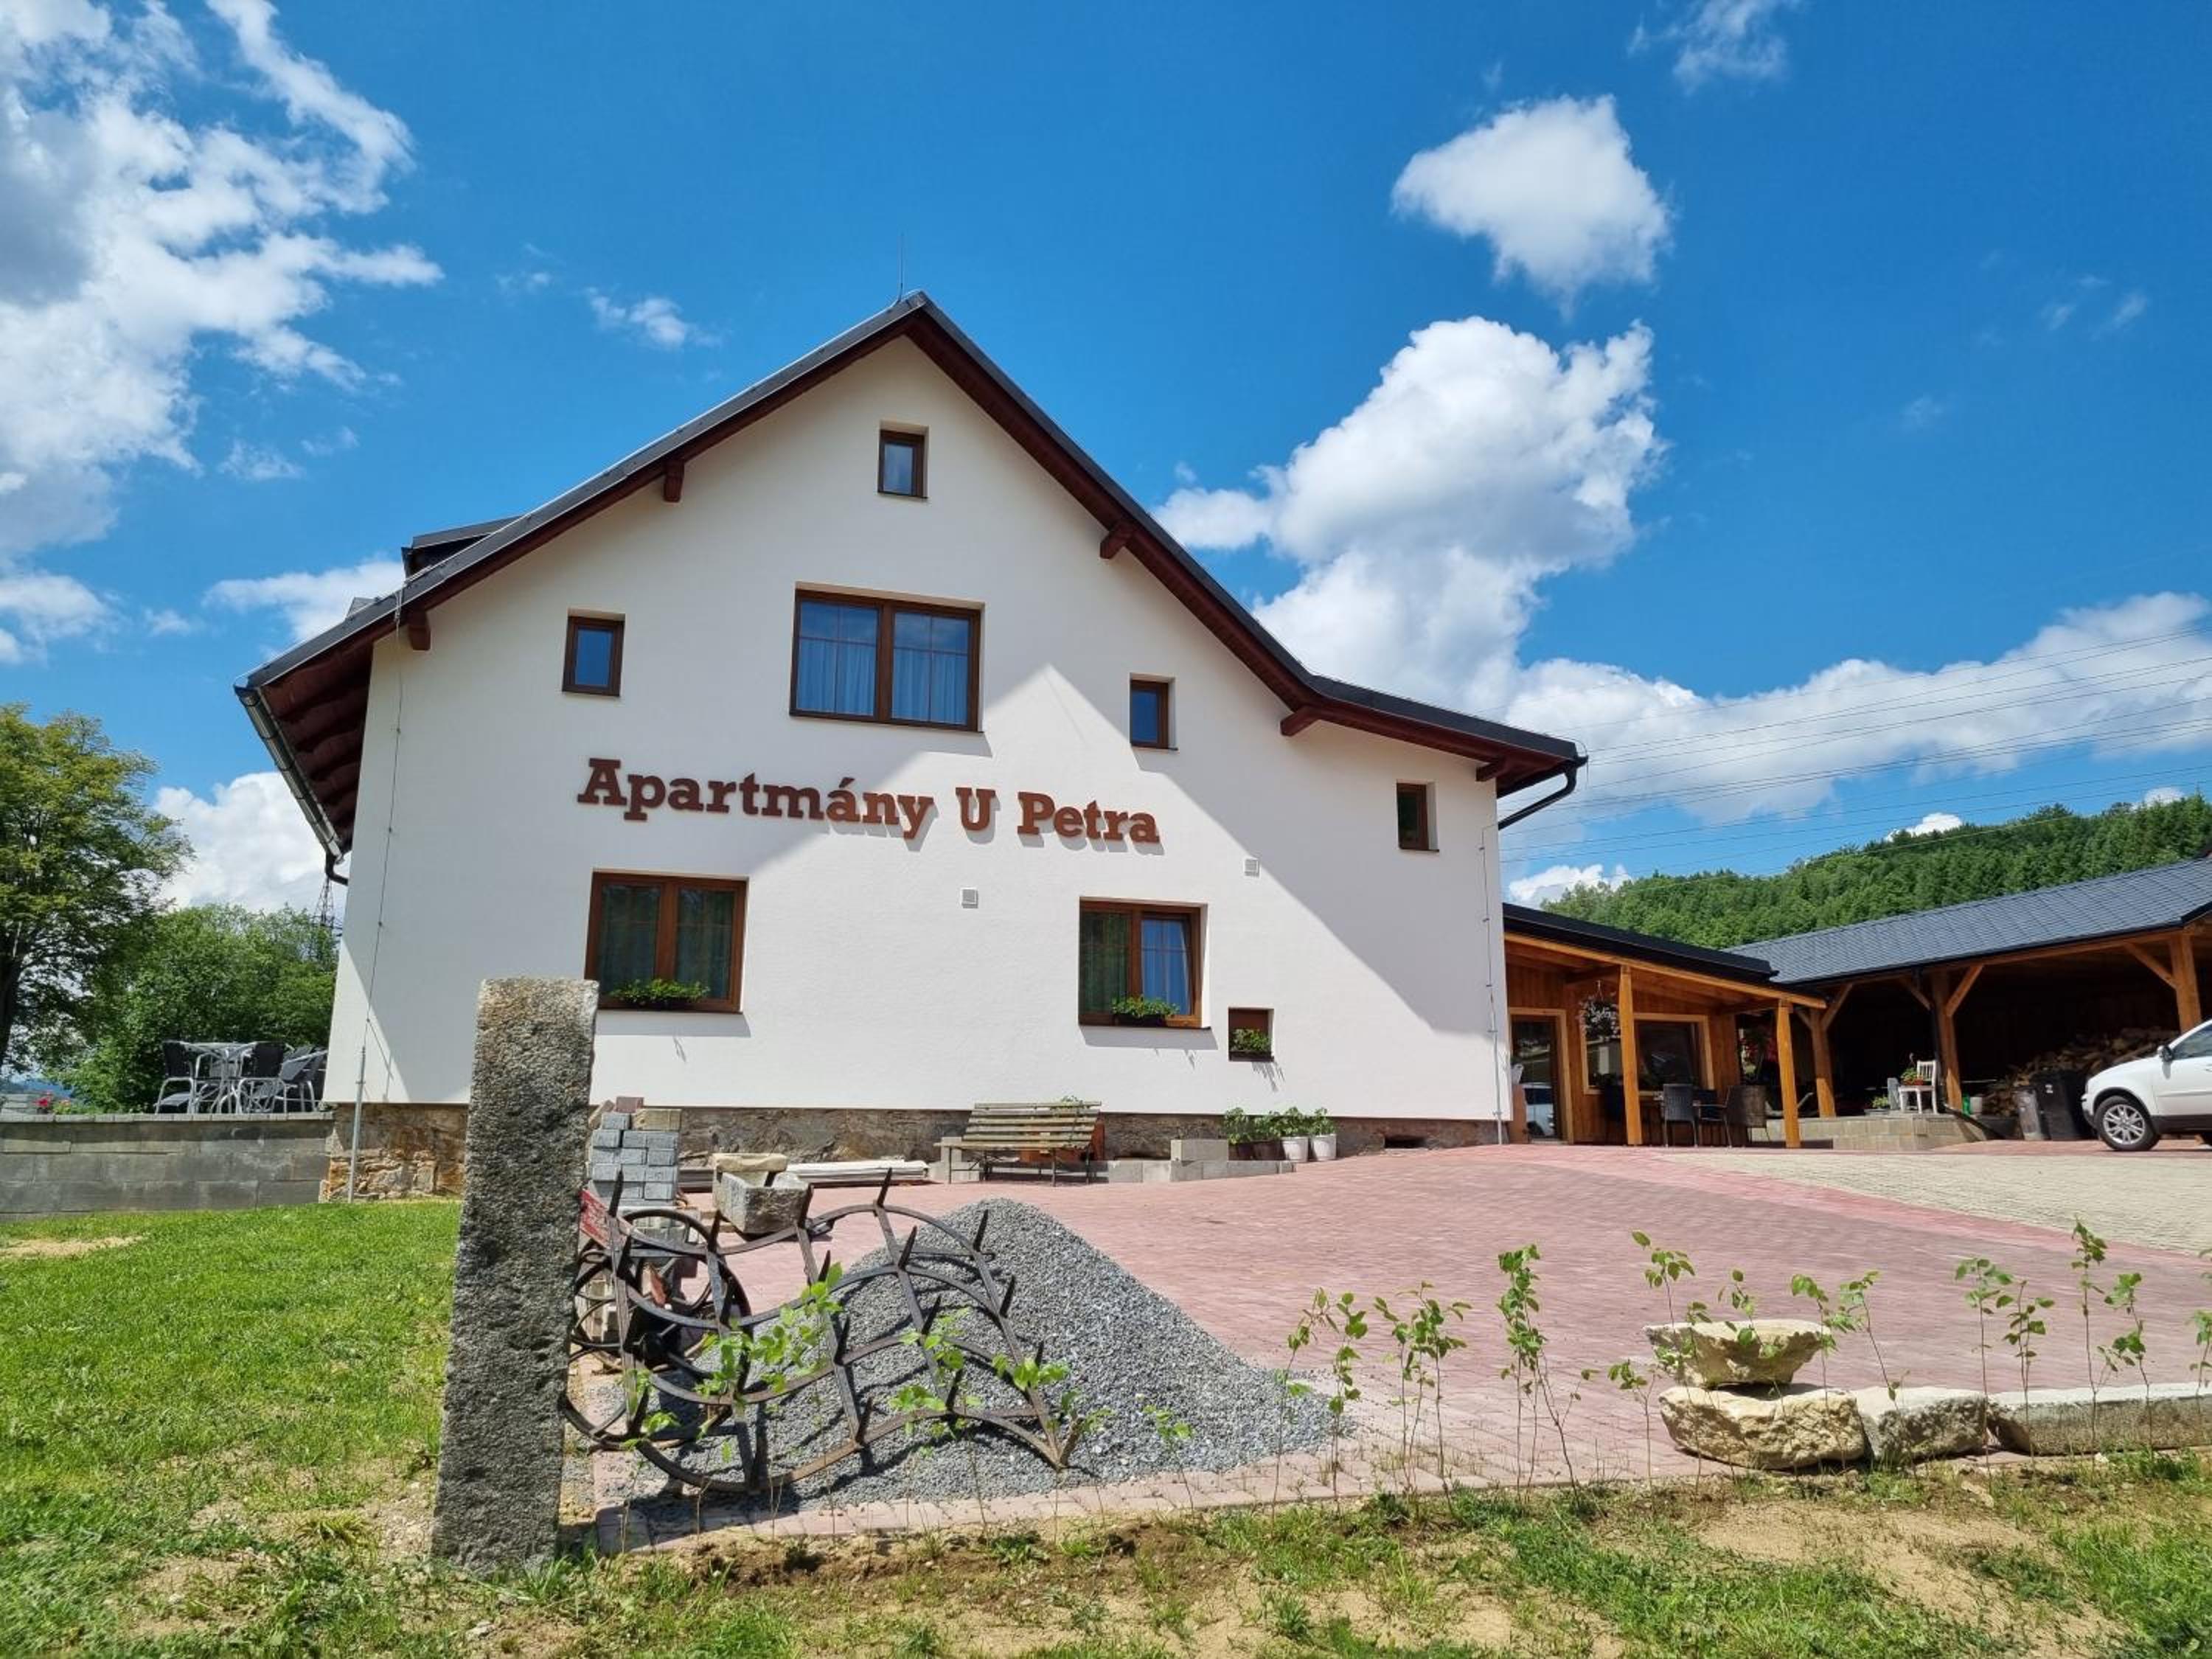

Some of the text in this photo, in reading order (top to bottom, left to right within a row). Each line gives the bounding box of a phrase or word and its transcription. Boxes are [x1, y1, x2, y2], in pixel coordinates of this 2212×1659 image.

[577, 757, 1161, 844] Apartmány U Petra
